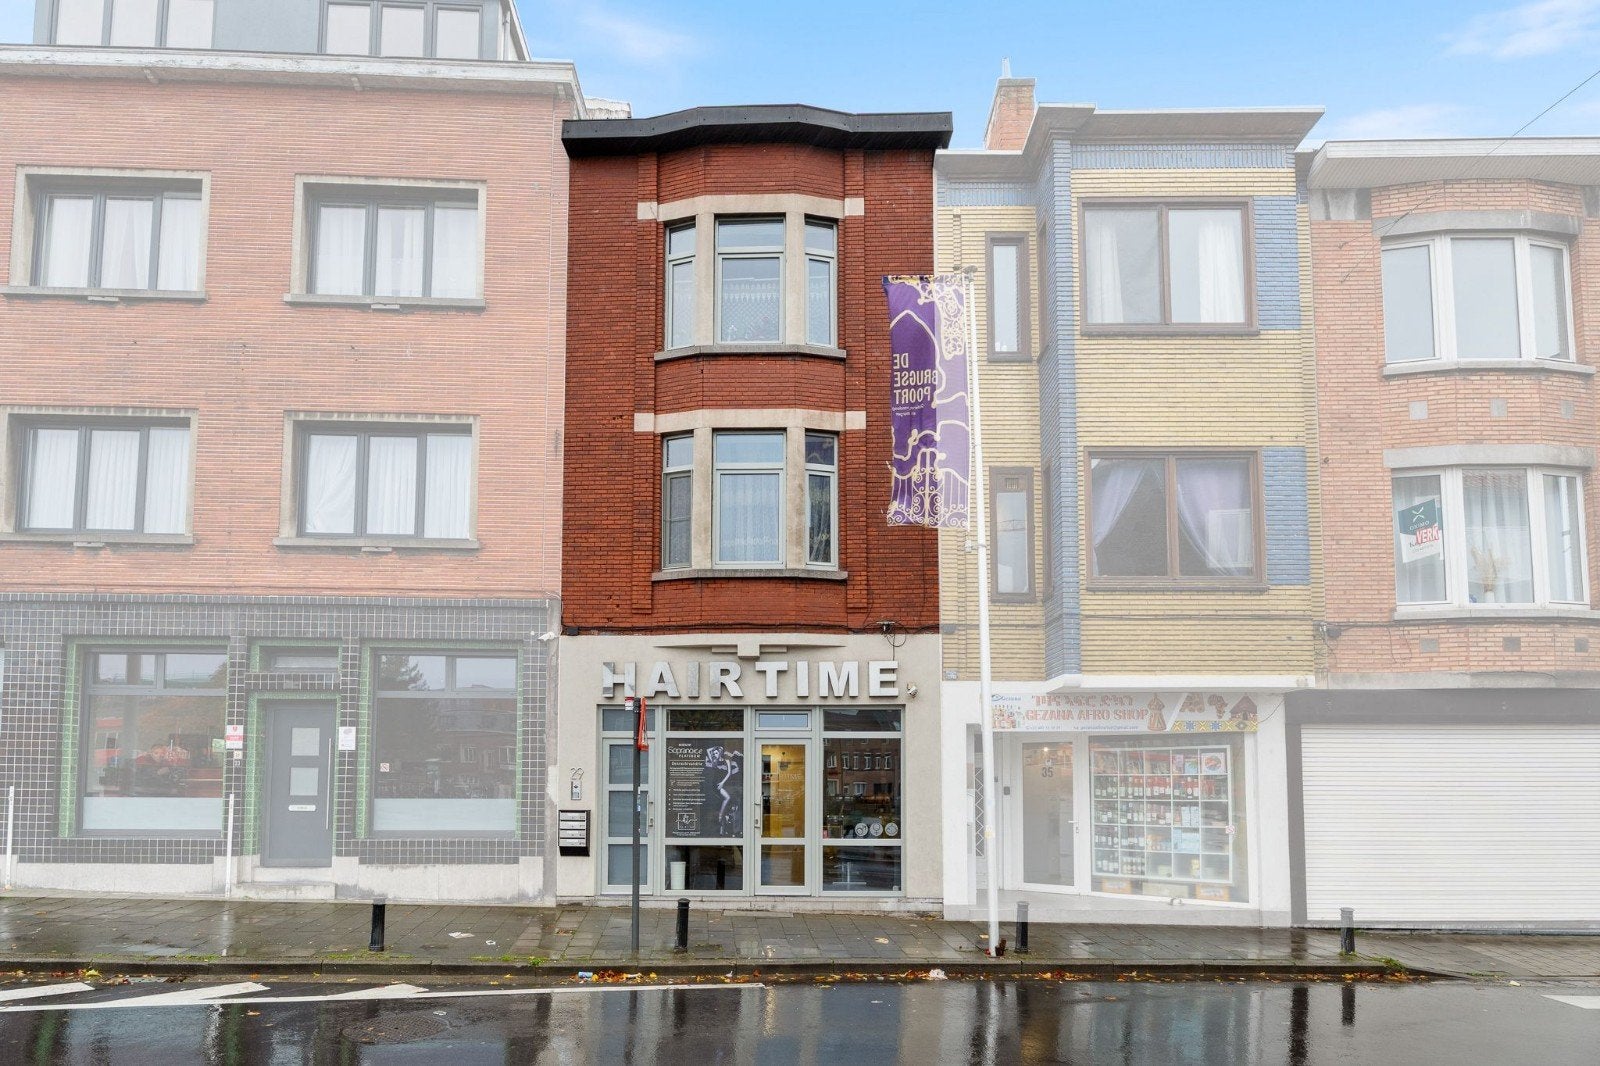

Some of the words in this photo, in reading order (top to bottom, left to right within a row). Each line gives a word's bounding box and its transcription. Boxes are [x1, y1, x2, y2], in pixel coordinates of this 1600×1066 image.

[602, 661, 744, 697] HAIR
[755, 660, 899, 697] TIME
[1077, 709, 1110, 720] AFRO
[1113, 709, 1148, 720] SHOP
[1041, 766, 1054, 778] 35
